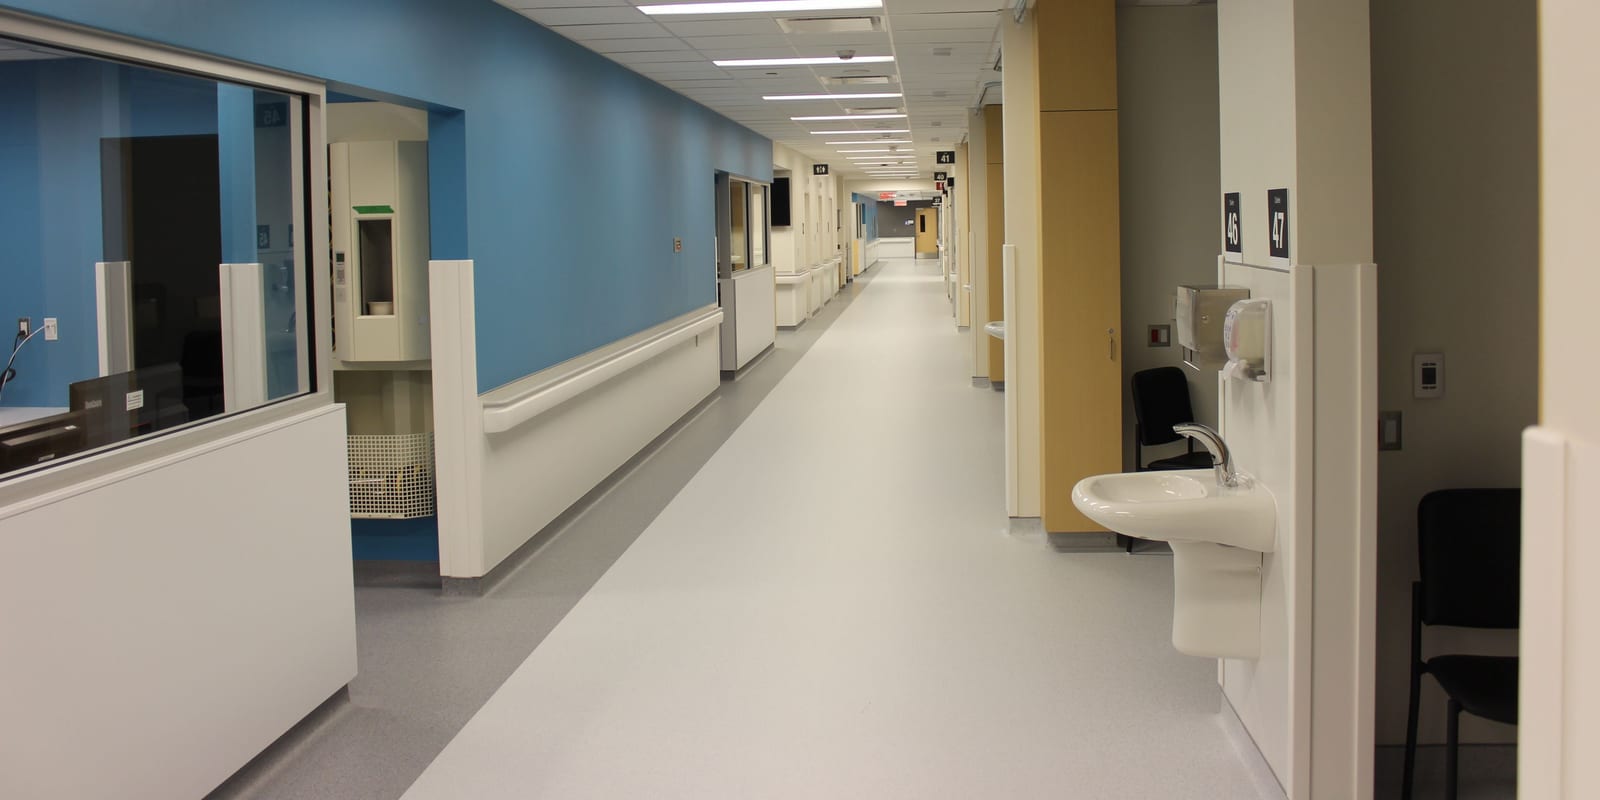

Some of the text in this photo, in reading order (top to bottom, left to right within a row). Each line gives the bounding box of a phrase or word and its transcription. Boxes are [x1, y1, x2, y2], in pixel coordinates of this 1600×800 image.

[941, 154, 950, 162] 41
[1227, 211, 1239, 246] 46
[1272, 211, 1285, 249] 47
